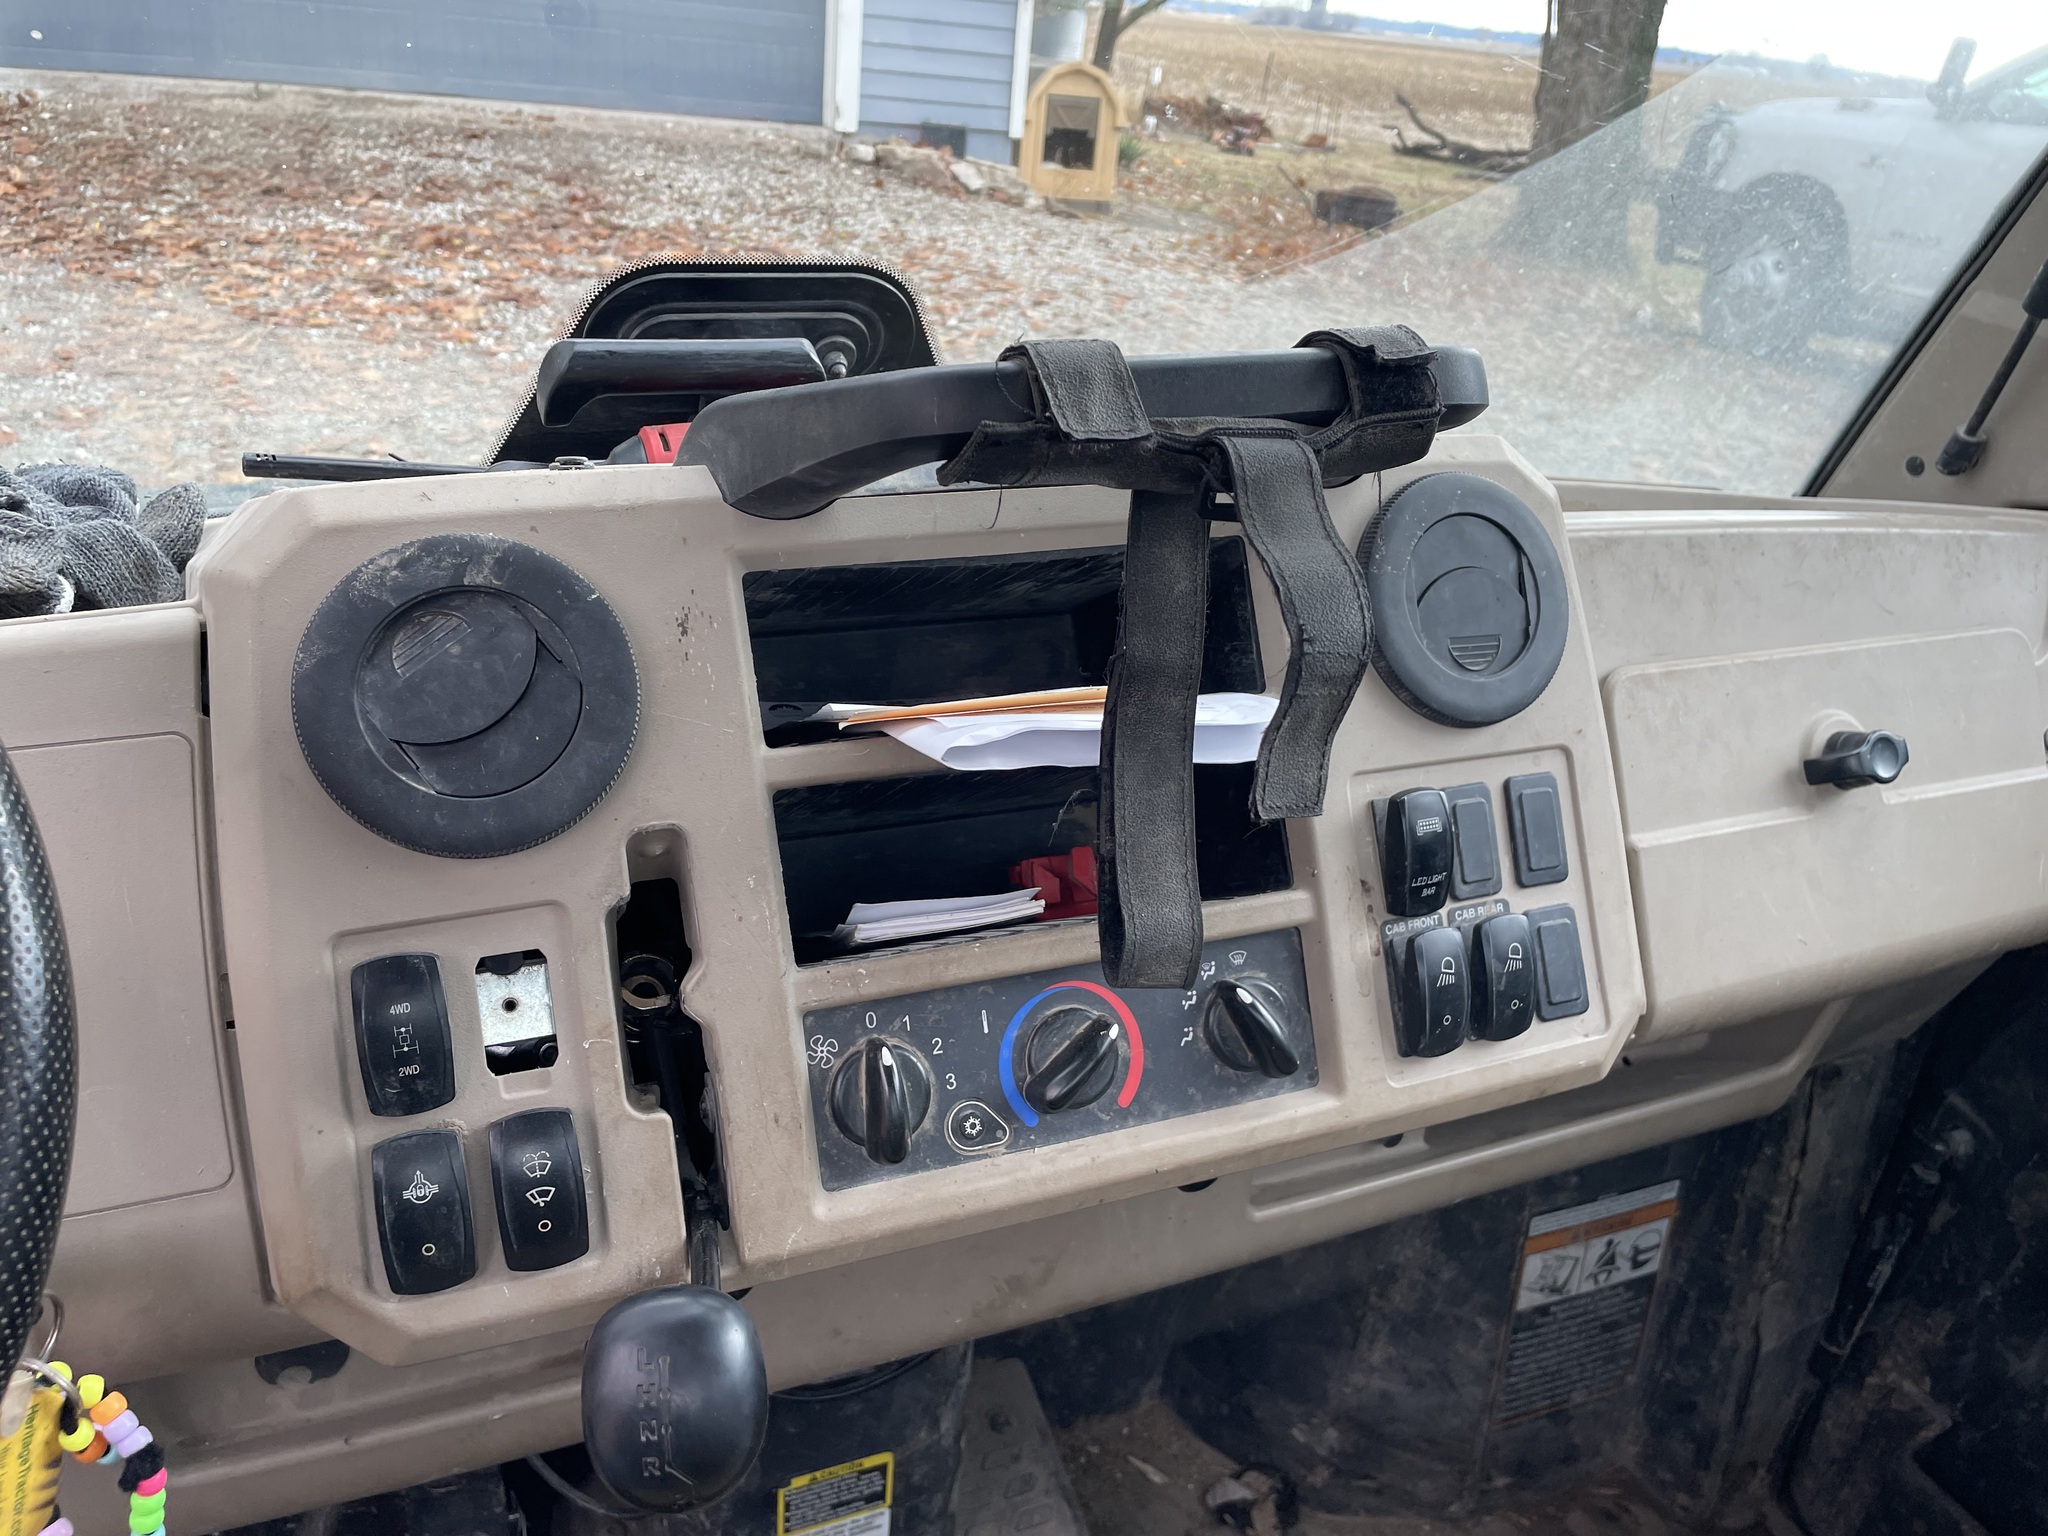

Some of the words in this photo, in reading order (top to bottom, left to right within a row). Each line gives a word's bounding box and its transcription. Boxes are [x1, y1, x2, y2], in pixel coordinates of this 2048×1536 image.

[1411, 876, 1428, 887] LED
[1428, 871, 1447, 884] LIGHT
[1421, 886, 1436, 897] BAR
[1455, 907, 1476, 920] CAB
[1477, 903, 1504, 916] REAR
[1385, 921, 1406, 935] CAB
[1407, 916, 1441, 931] FRONT
[389, 1002, 411, 1015] 4WD
[865, 1011, 877, 1029] 0
[902, 1015, 911, 1032] 1
[931, 1037, 944, 1055] 2
[398, 1064, 420, 1077] 2WD
[945, 1072, 957, 1090] 3
[637, 1346, 655, 1372] L
[636, 1383, 657, 1408] H
[639, 1419, 658, 1442] N
[642, 1457, 661, 1477] R
